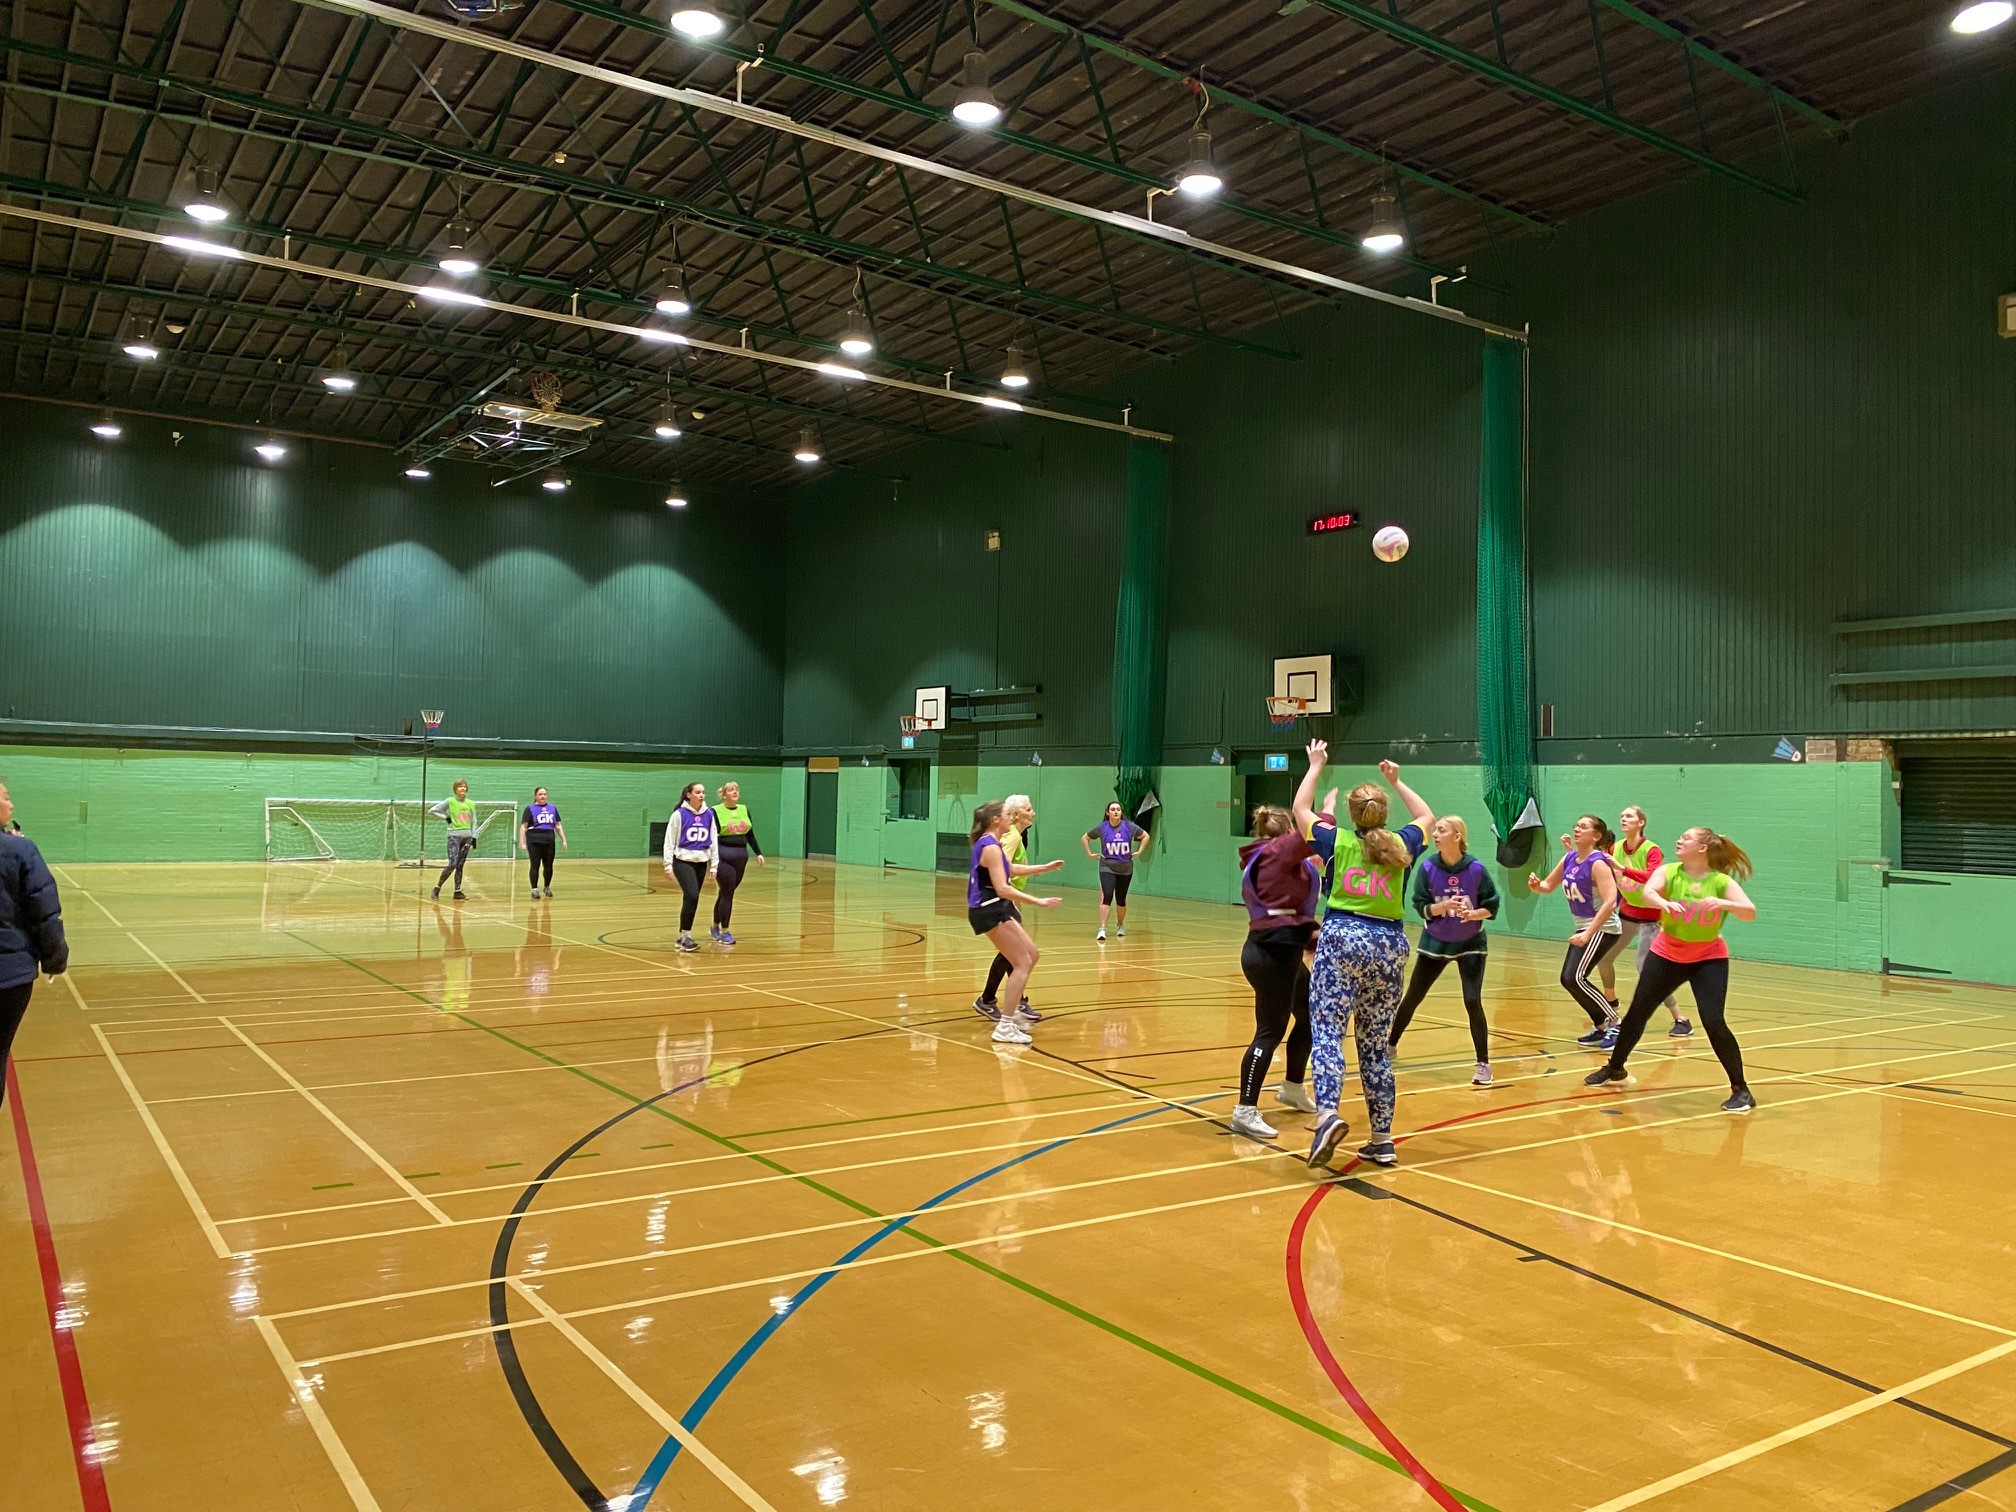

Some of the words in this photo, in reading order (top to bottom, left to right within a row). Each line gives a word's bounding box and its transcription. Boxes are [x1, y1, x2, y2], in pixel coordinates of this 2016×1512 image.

[536, 813, 554, 824] GK
[726, 819, 748, 833] GA
[686, 826, 709, 842] GD
[1106, 841, 1130, 856] WD
[1342, 867, 1394, 900] GK
[1562, 878, 1587, 904] GA
[1669, 899, 1721, 926] WD
